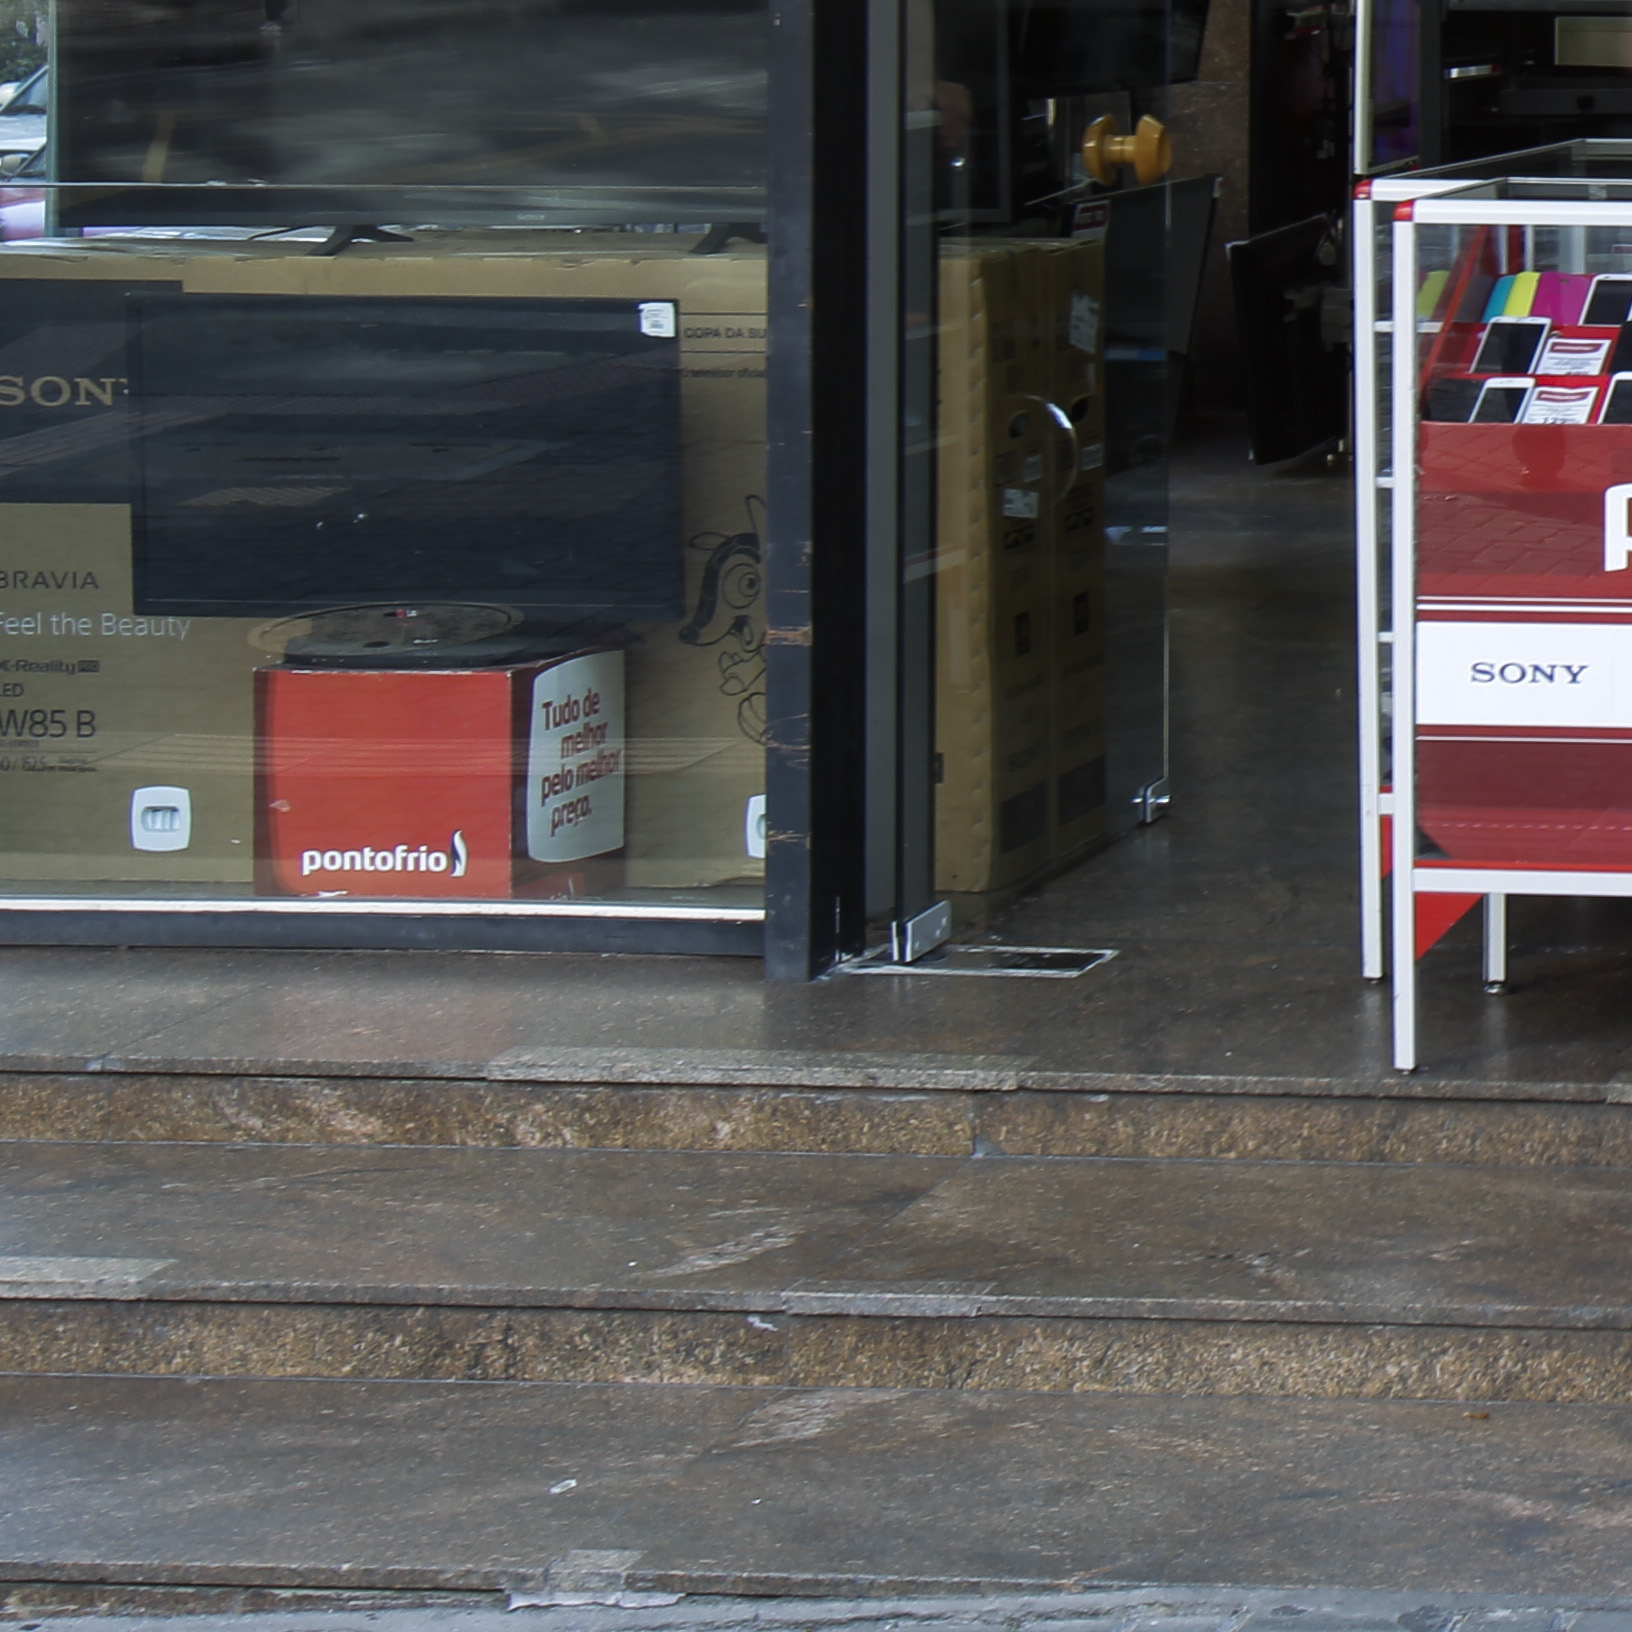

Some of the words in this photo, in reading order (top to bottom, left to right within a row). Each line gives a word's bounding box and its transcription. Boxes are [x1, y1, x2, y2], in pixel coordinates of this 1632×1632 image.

[0, 374, 129, 407] SON
[50, 612, 93, 636] the
[101, 612, 191, 641] Beauty
[1469, 661, 1589, 685] SONY
[76, 709, 97, 739] B
[541, 694, 580, 731] Tudo
[583, 687, 600, 718] de
[561, 720, 609, 760] melhor
[540, 763, 574, 807] pelo
[575, 749, 622, 789] melhor
[550, 793, 593, 838] preço.
[302, 844, 449, 876] pontofrio
